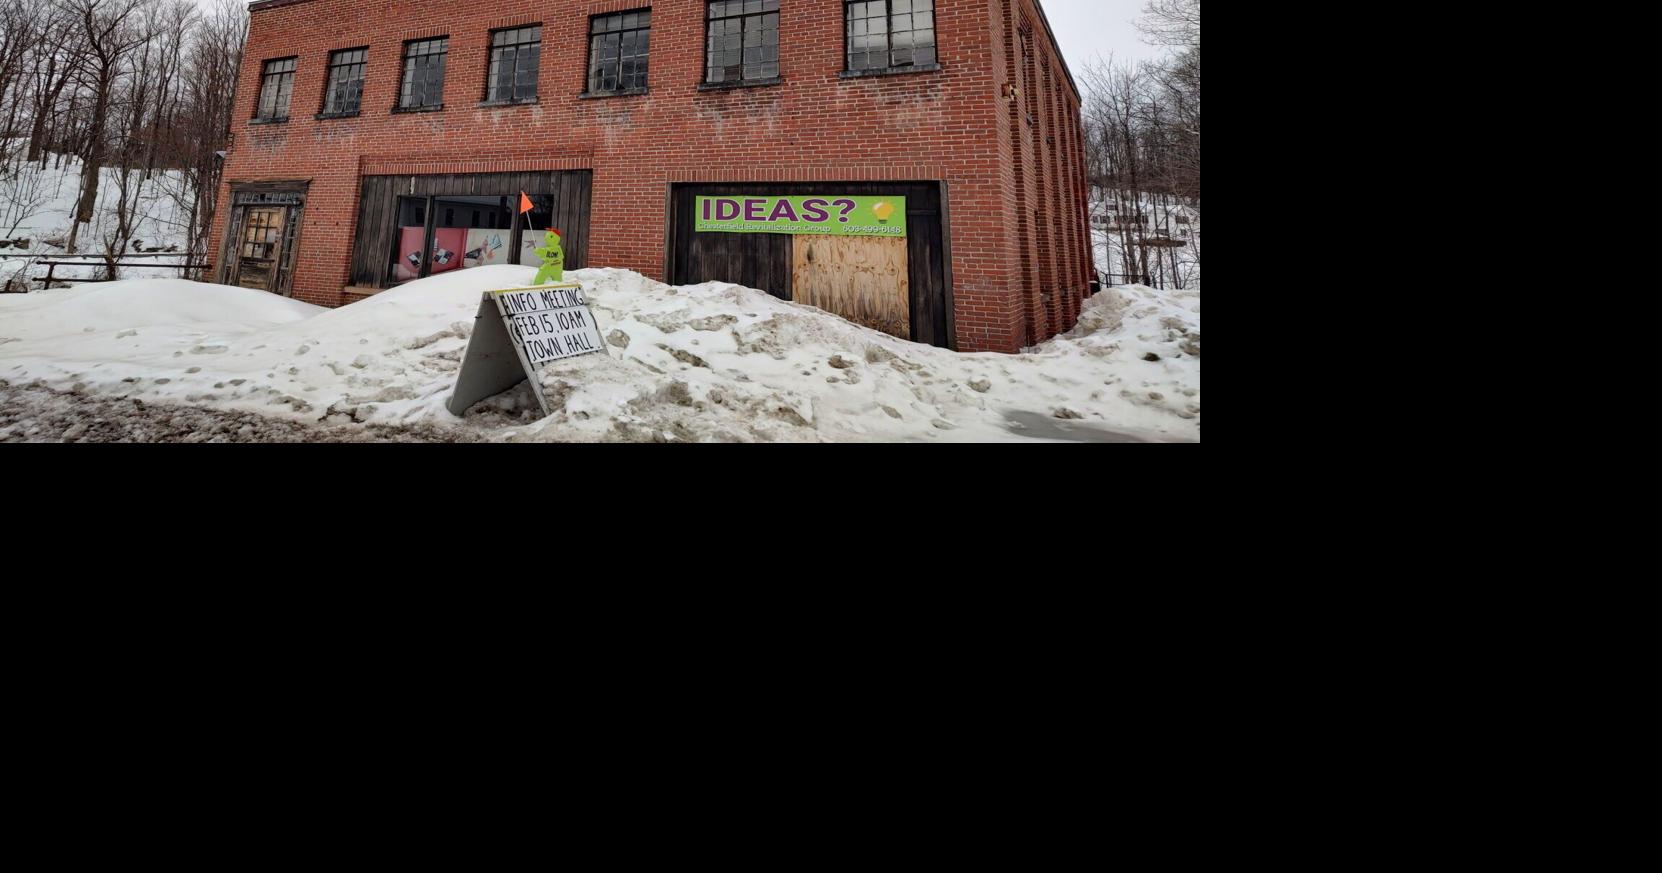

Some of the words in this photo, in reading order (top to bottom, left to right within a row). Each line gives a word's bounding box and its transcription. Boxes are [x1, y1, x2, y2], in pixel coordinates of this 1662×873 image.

[702, 198, 856, 222] IDEAS?
[804, 224, 831, 233] Group
[507, 293, 537, 313] INFO
[540, 289, 583, 309] MEETING
[516, 317, 540, 336] FEB
[526, 337, 564, 361] TOWN
[564, 332, 593, 352] HALL
